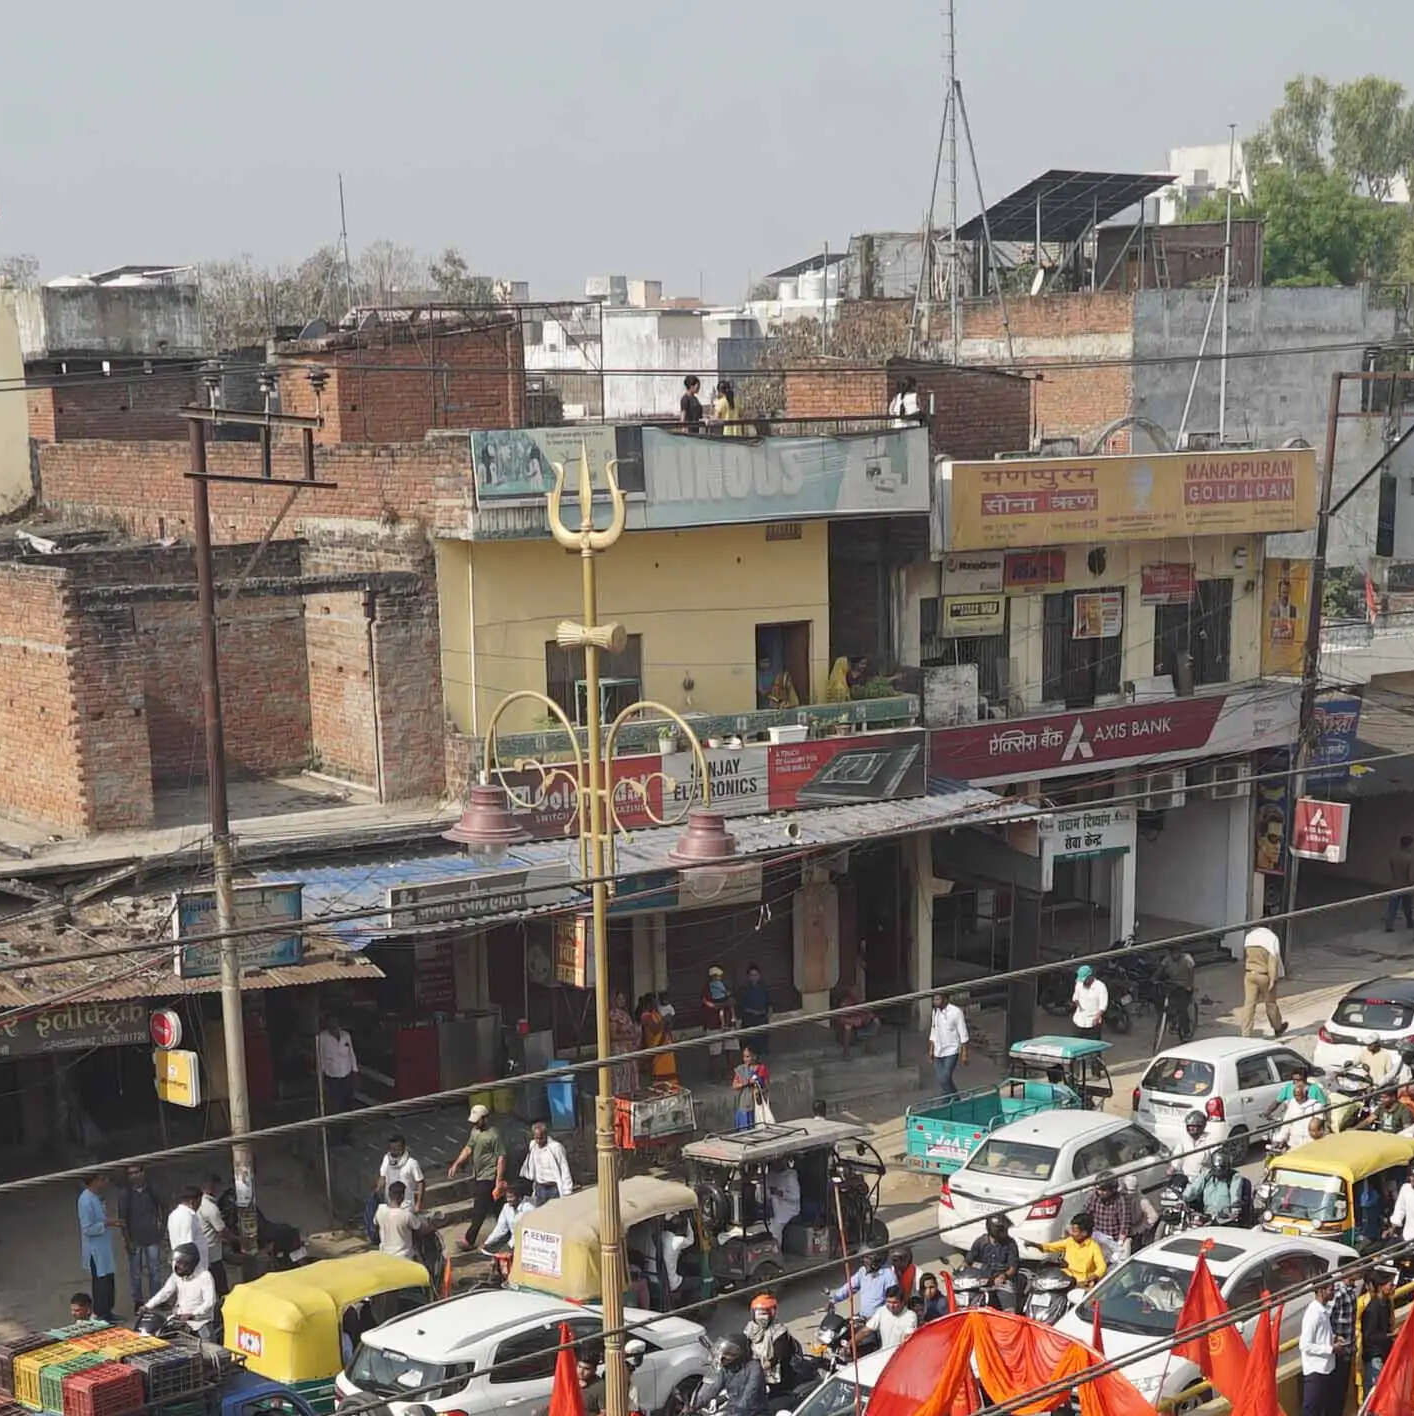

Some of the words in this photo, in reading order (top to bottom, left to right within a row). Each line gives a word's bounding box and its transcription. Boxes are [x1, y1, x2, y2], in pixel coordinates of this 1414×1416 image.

[1187, 460, 1293, 480] MANAPPURAM
[1189, 485, 1237, 501] GOLD
[1244, 482, 1293, 499] LOAN
[984, 495, 1037, 514] सोना
[1093, 723, 1127, 742] AXIS
[1130, 717, 1172, 736] BANK
[690, 758, 741, 779] SNJAY
